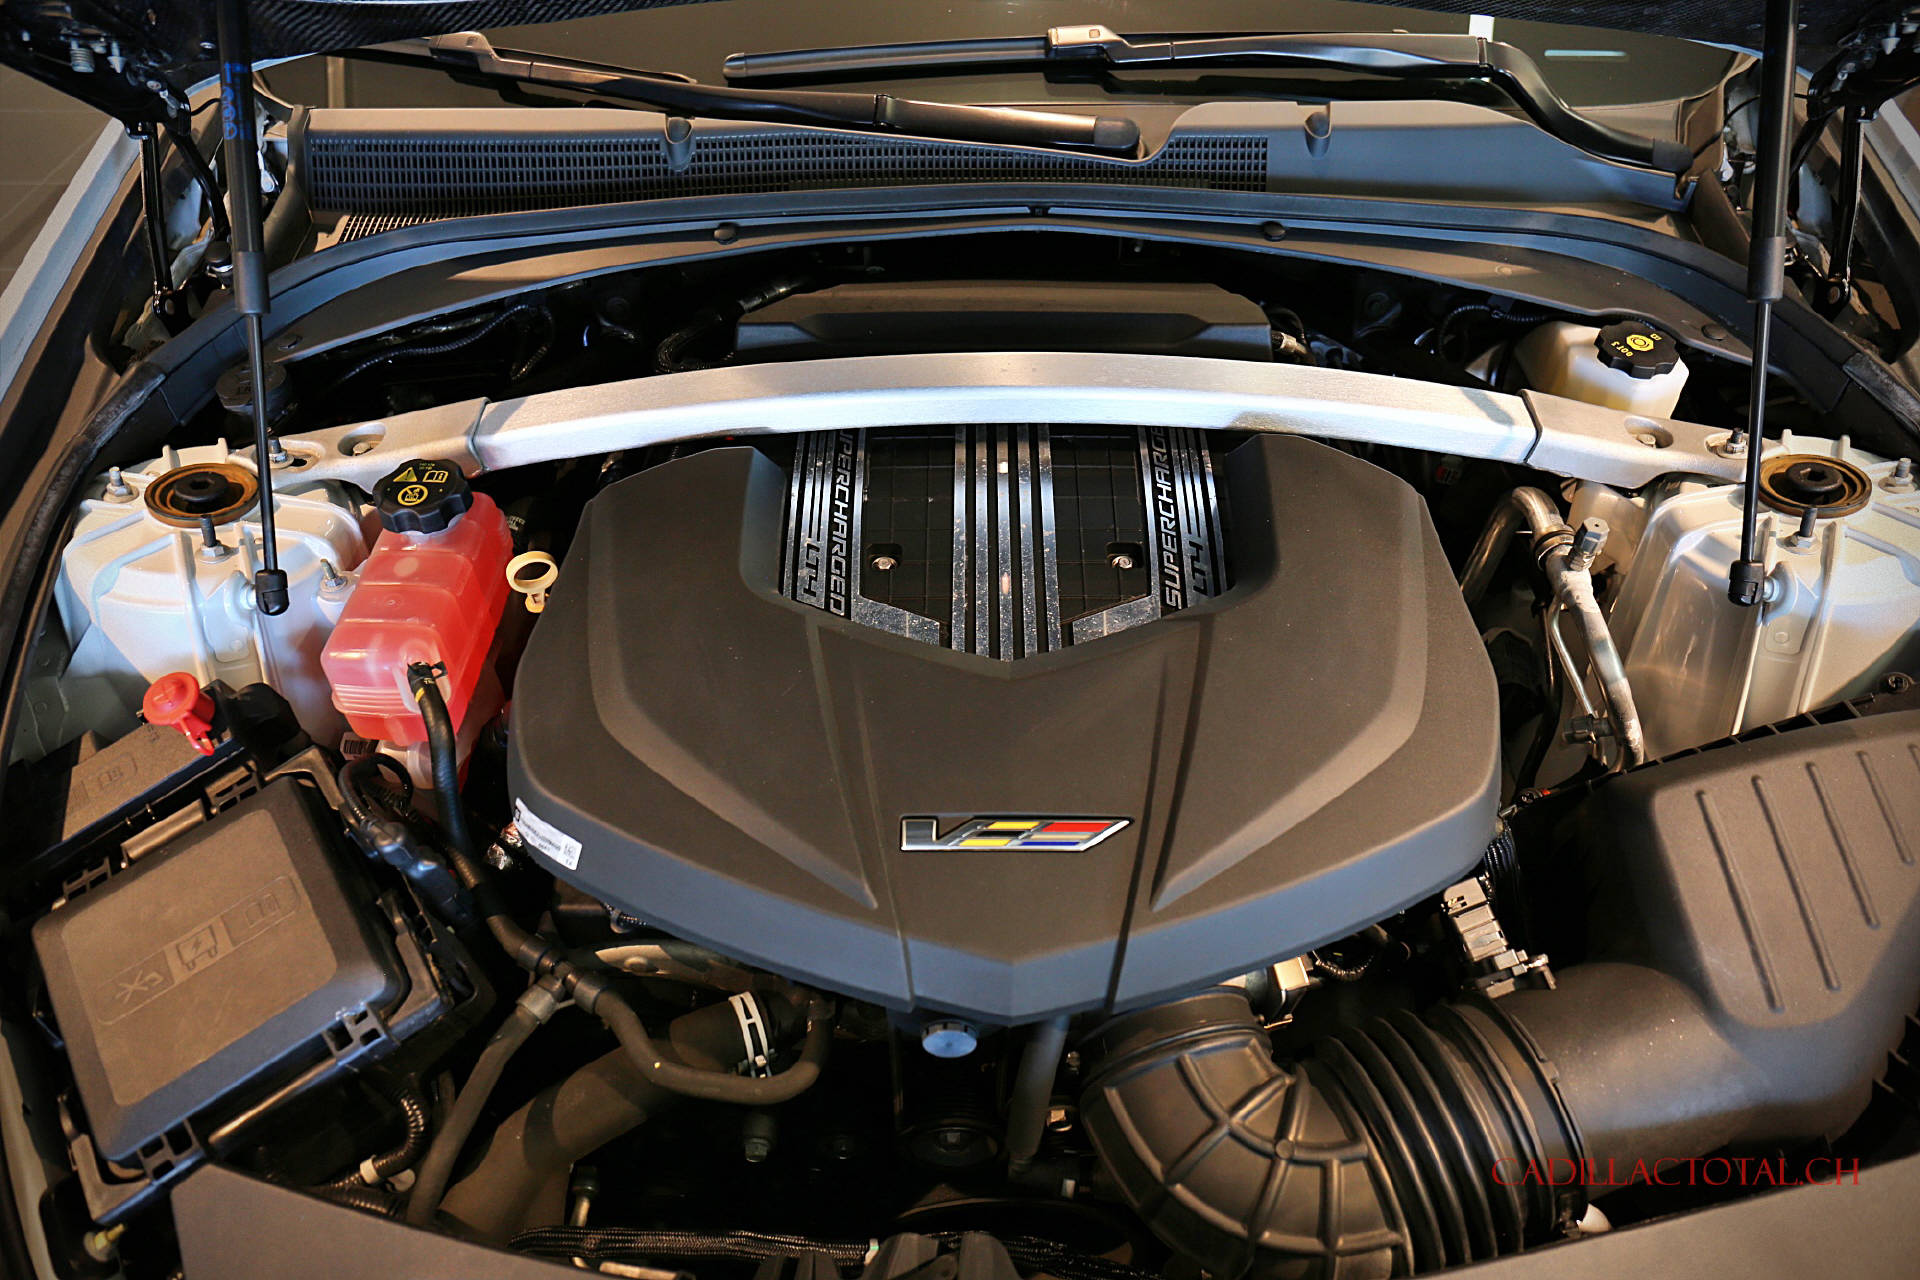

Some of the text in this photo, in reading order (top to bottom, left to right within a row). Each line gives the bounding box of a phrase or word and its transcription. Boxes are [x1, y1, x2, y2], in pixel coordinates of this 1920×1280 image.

[803, 542, 820, 598] LT4
[829, 430, 853, 616] UPERCHARGED
[1151, 427, 1182, 610] SUPERCHARGE
[1188, 540, 1208, 597] LT4
